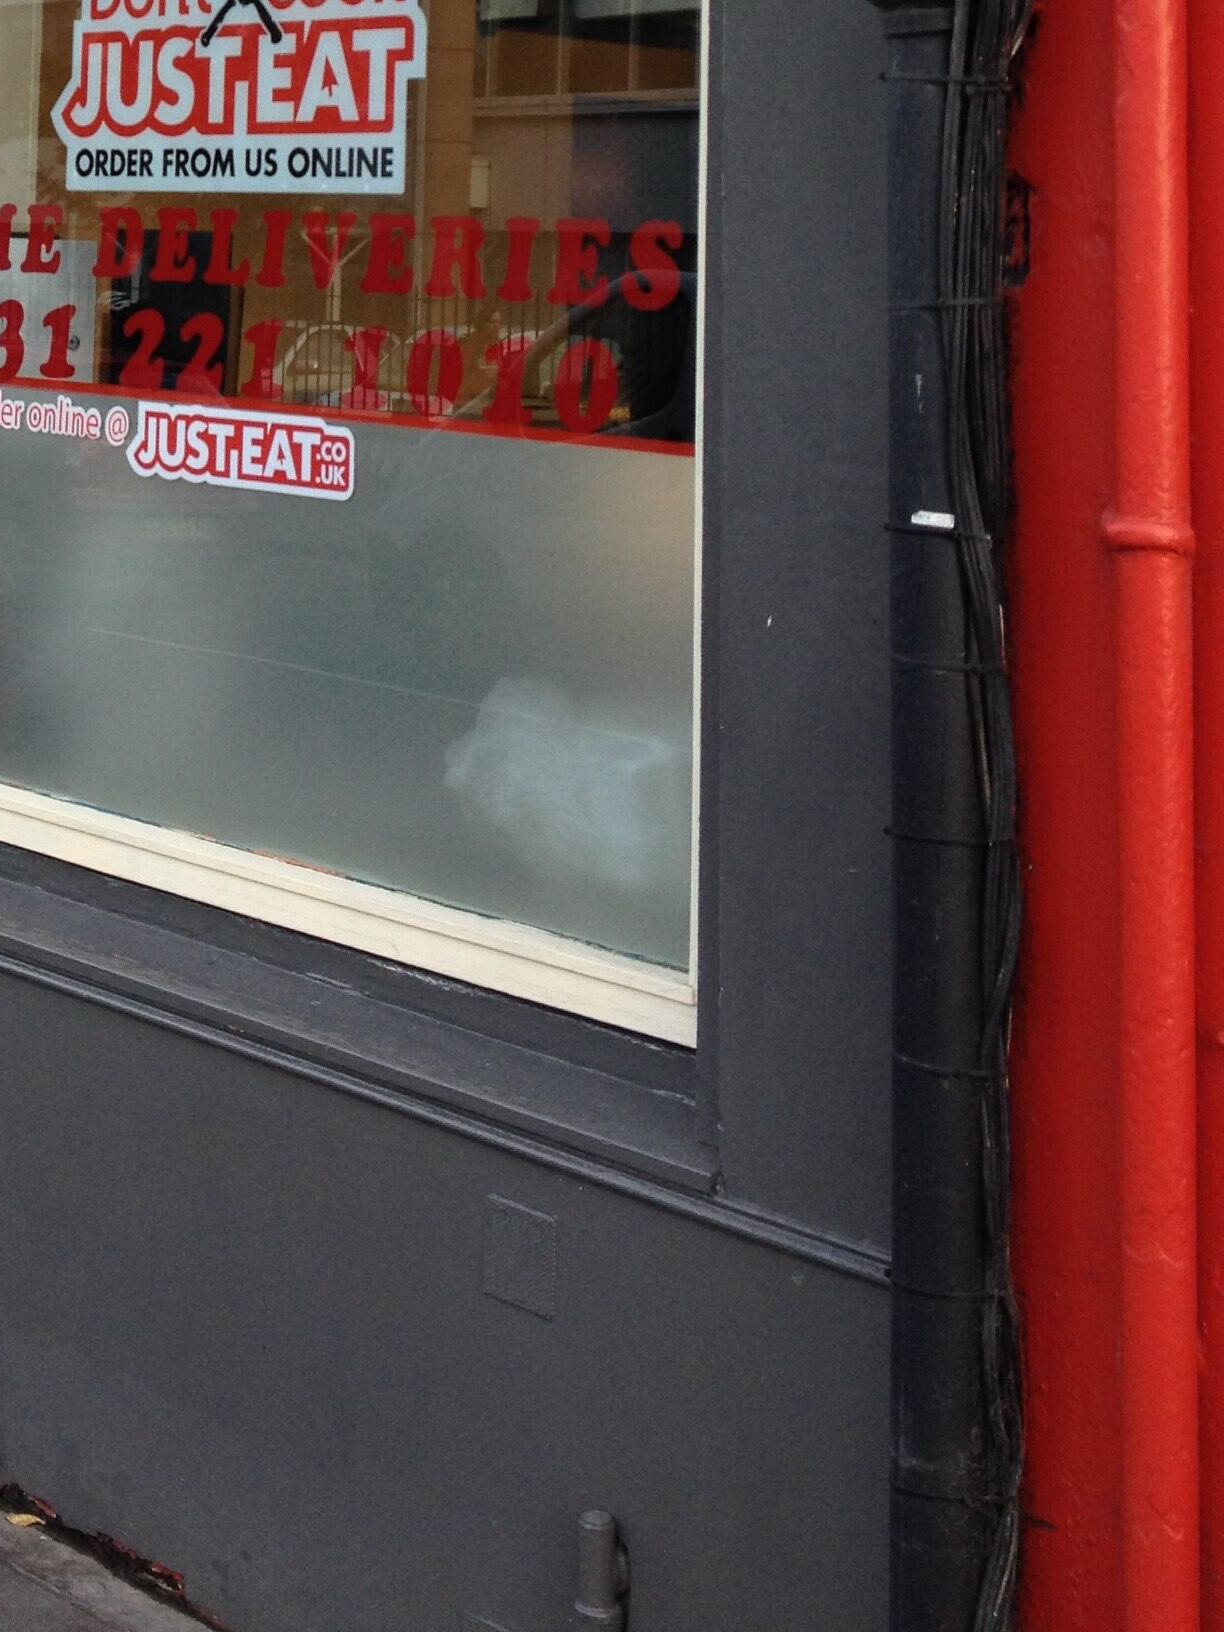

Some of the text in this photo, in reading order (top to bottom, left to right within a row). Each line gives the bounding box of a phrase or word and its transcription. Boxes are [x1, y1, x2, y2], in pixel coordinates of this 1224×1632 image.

[70, 27, 406, 126] JUST EAT
[75, 147, 394, 178] ORDER FROM US ONLINE
[92, 206, 684, 312] DELIVERIES
[119, 308, 285, 400] 221
[344, 325, 619, 434] 1010
[27, 396, 102, 441] online
[106, 406, 131, 448] @
[140, 417, 230, 471] JUST
